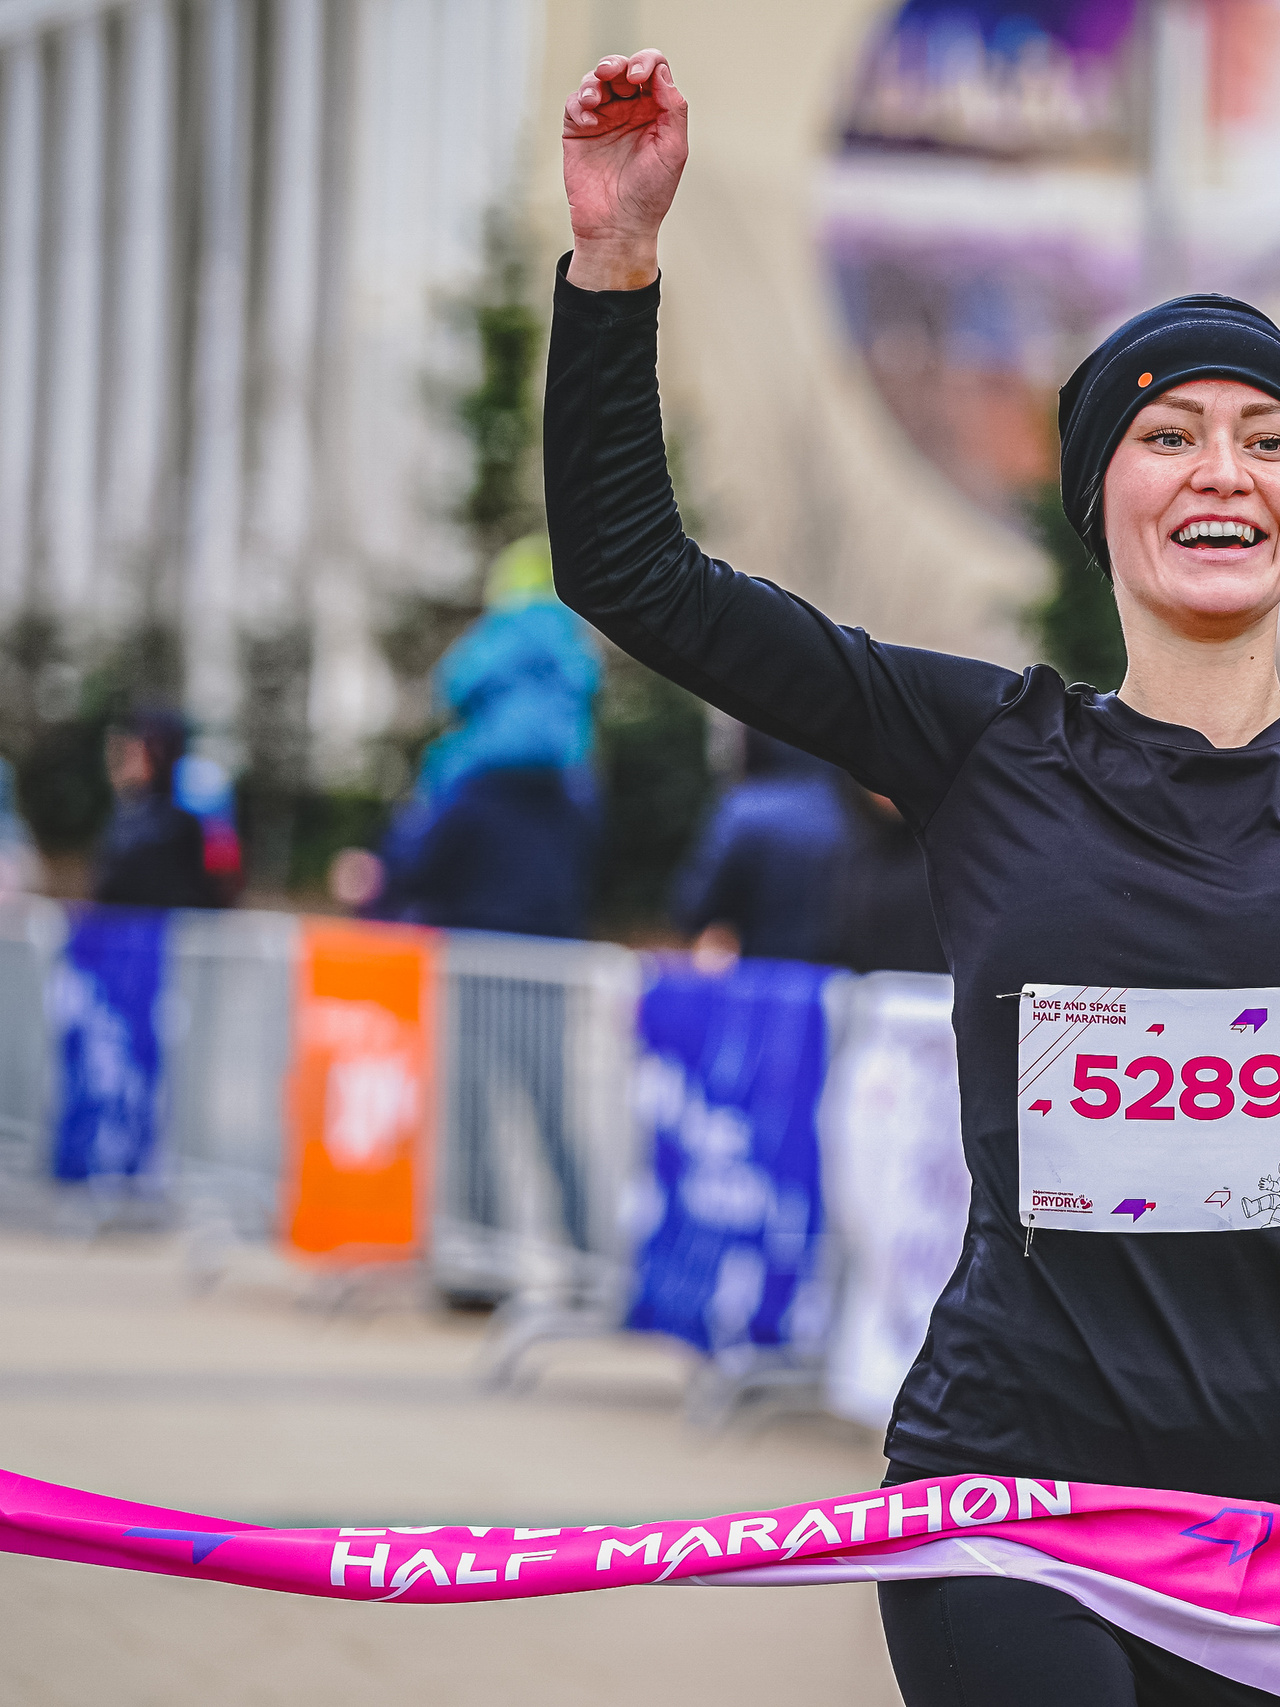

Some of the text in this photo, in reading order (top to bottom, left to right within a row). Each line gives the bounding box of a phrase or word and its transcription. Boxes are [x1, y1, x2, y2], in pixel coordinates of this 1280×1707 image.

[1063, 1001, 1087, 1011] AND
[1089, 1002, 1127, 1013] SPACE
[1032, 1011, 1061, 1022] HALF
[330, 1541, 558, 1592] HALF
